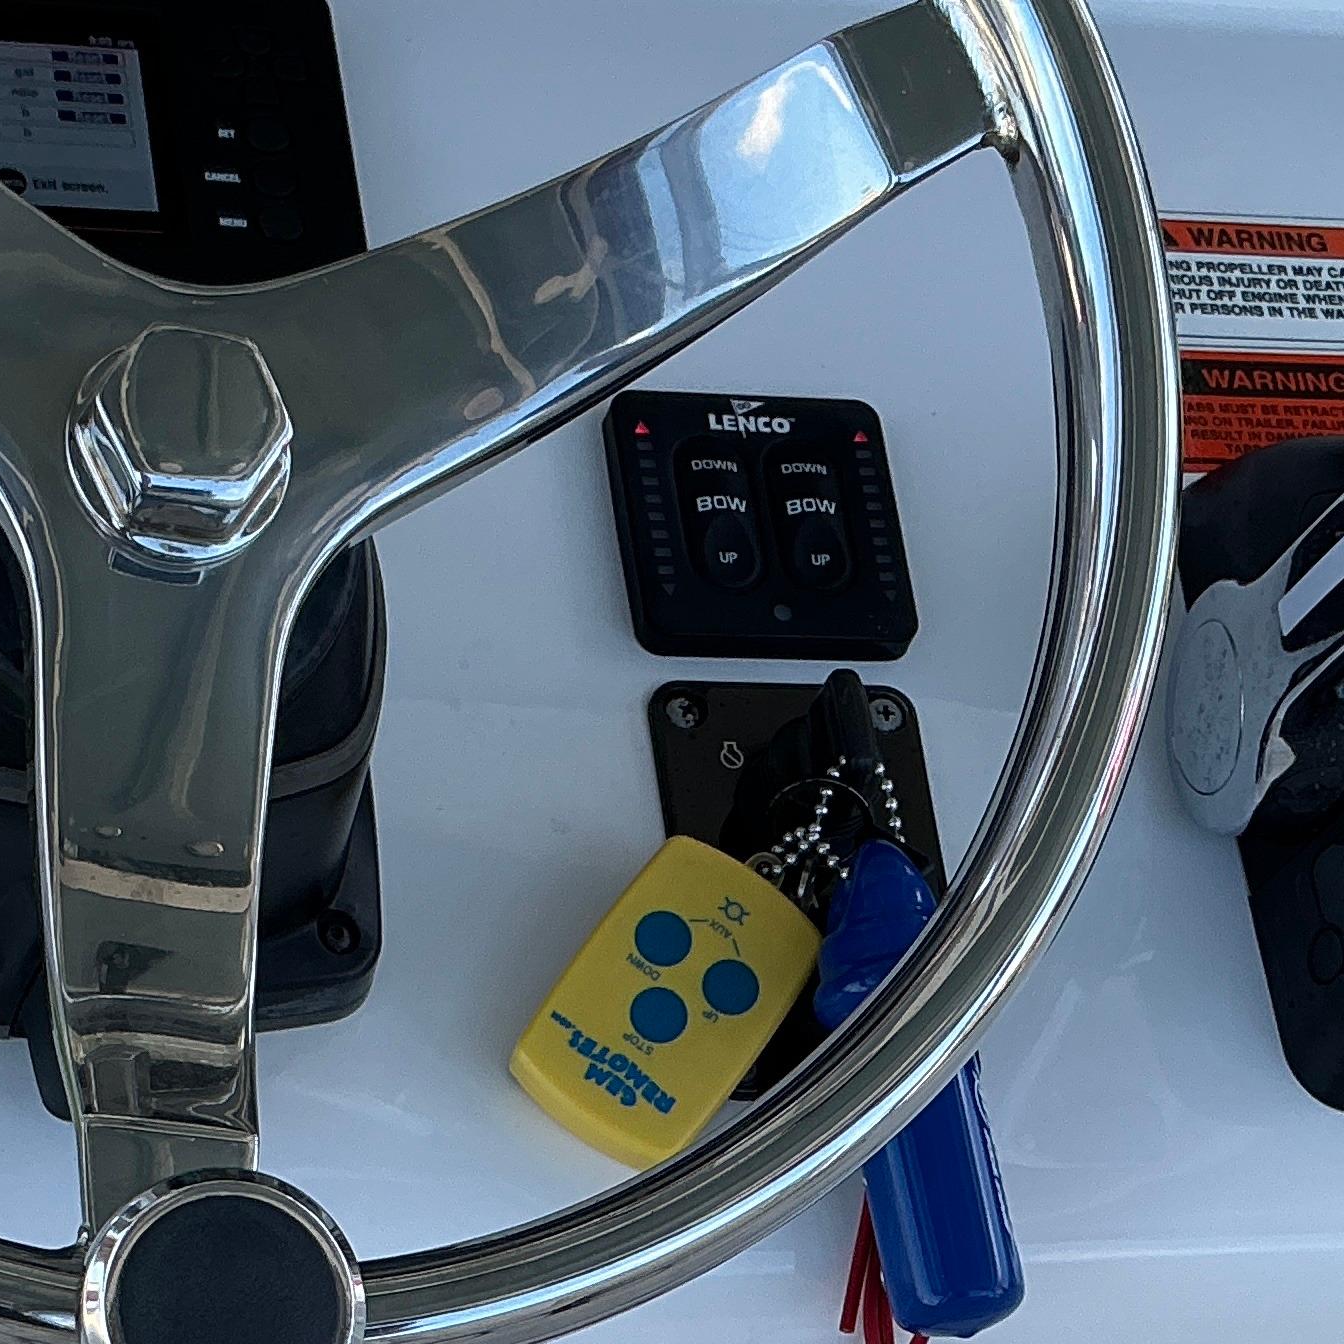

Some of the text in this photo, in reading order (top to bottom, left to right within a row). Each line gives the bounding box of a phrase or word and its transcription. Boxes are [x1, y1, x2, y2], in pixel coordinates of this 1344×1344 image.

[1186, 226, 1329, 253] WARNING
[1195, 261, 1288, 276] PROPELLER
[1292, 265, 1323, 278] MAY
[1216, 276, 1272, 289] INJURY
[1276, 279, 1300, 291] OR
[1171, 288, 1202, 300] HUT
[1206, 289, 1236, 301] OFF
[1240, 290, 1300, 304] ENGINE
[1189, 303, 1264, 317] PERSONS
[1267, 306, 1284, 318] IN
[1286, 306, 1318, 319] THE
[1187, 402, 1215, 413] ABS
[1219, 402, 1256, 415] MUST
[1260, 404, 1281, 416] BE
[708, 412, 791, 435] LENCO
[1213, 416, 1233, 427] ON
[1191, 429, 1244, 440] RESULT
[1248, 431, 1261, 441] IN
[691, 459, 738, 473] DOWN
[780, 463, 827, 475] DOWN
[696, 495, 747, 513] BOW
[786, 498, 837, 515] BOW
[719, 551, 738, 564] UP
[810, 553, 831, 566] UP
[708, 918, 733, 940] AUX
[626, 951, 662, 981] DOWN
[701, 1008, 720, 1024] UP
[622, 1032, 655, 1056] STOP
[583, 1061, 638, 1108] GEM
